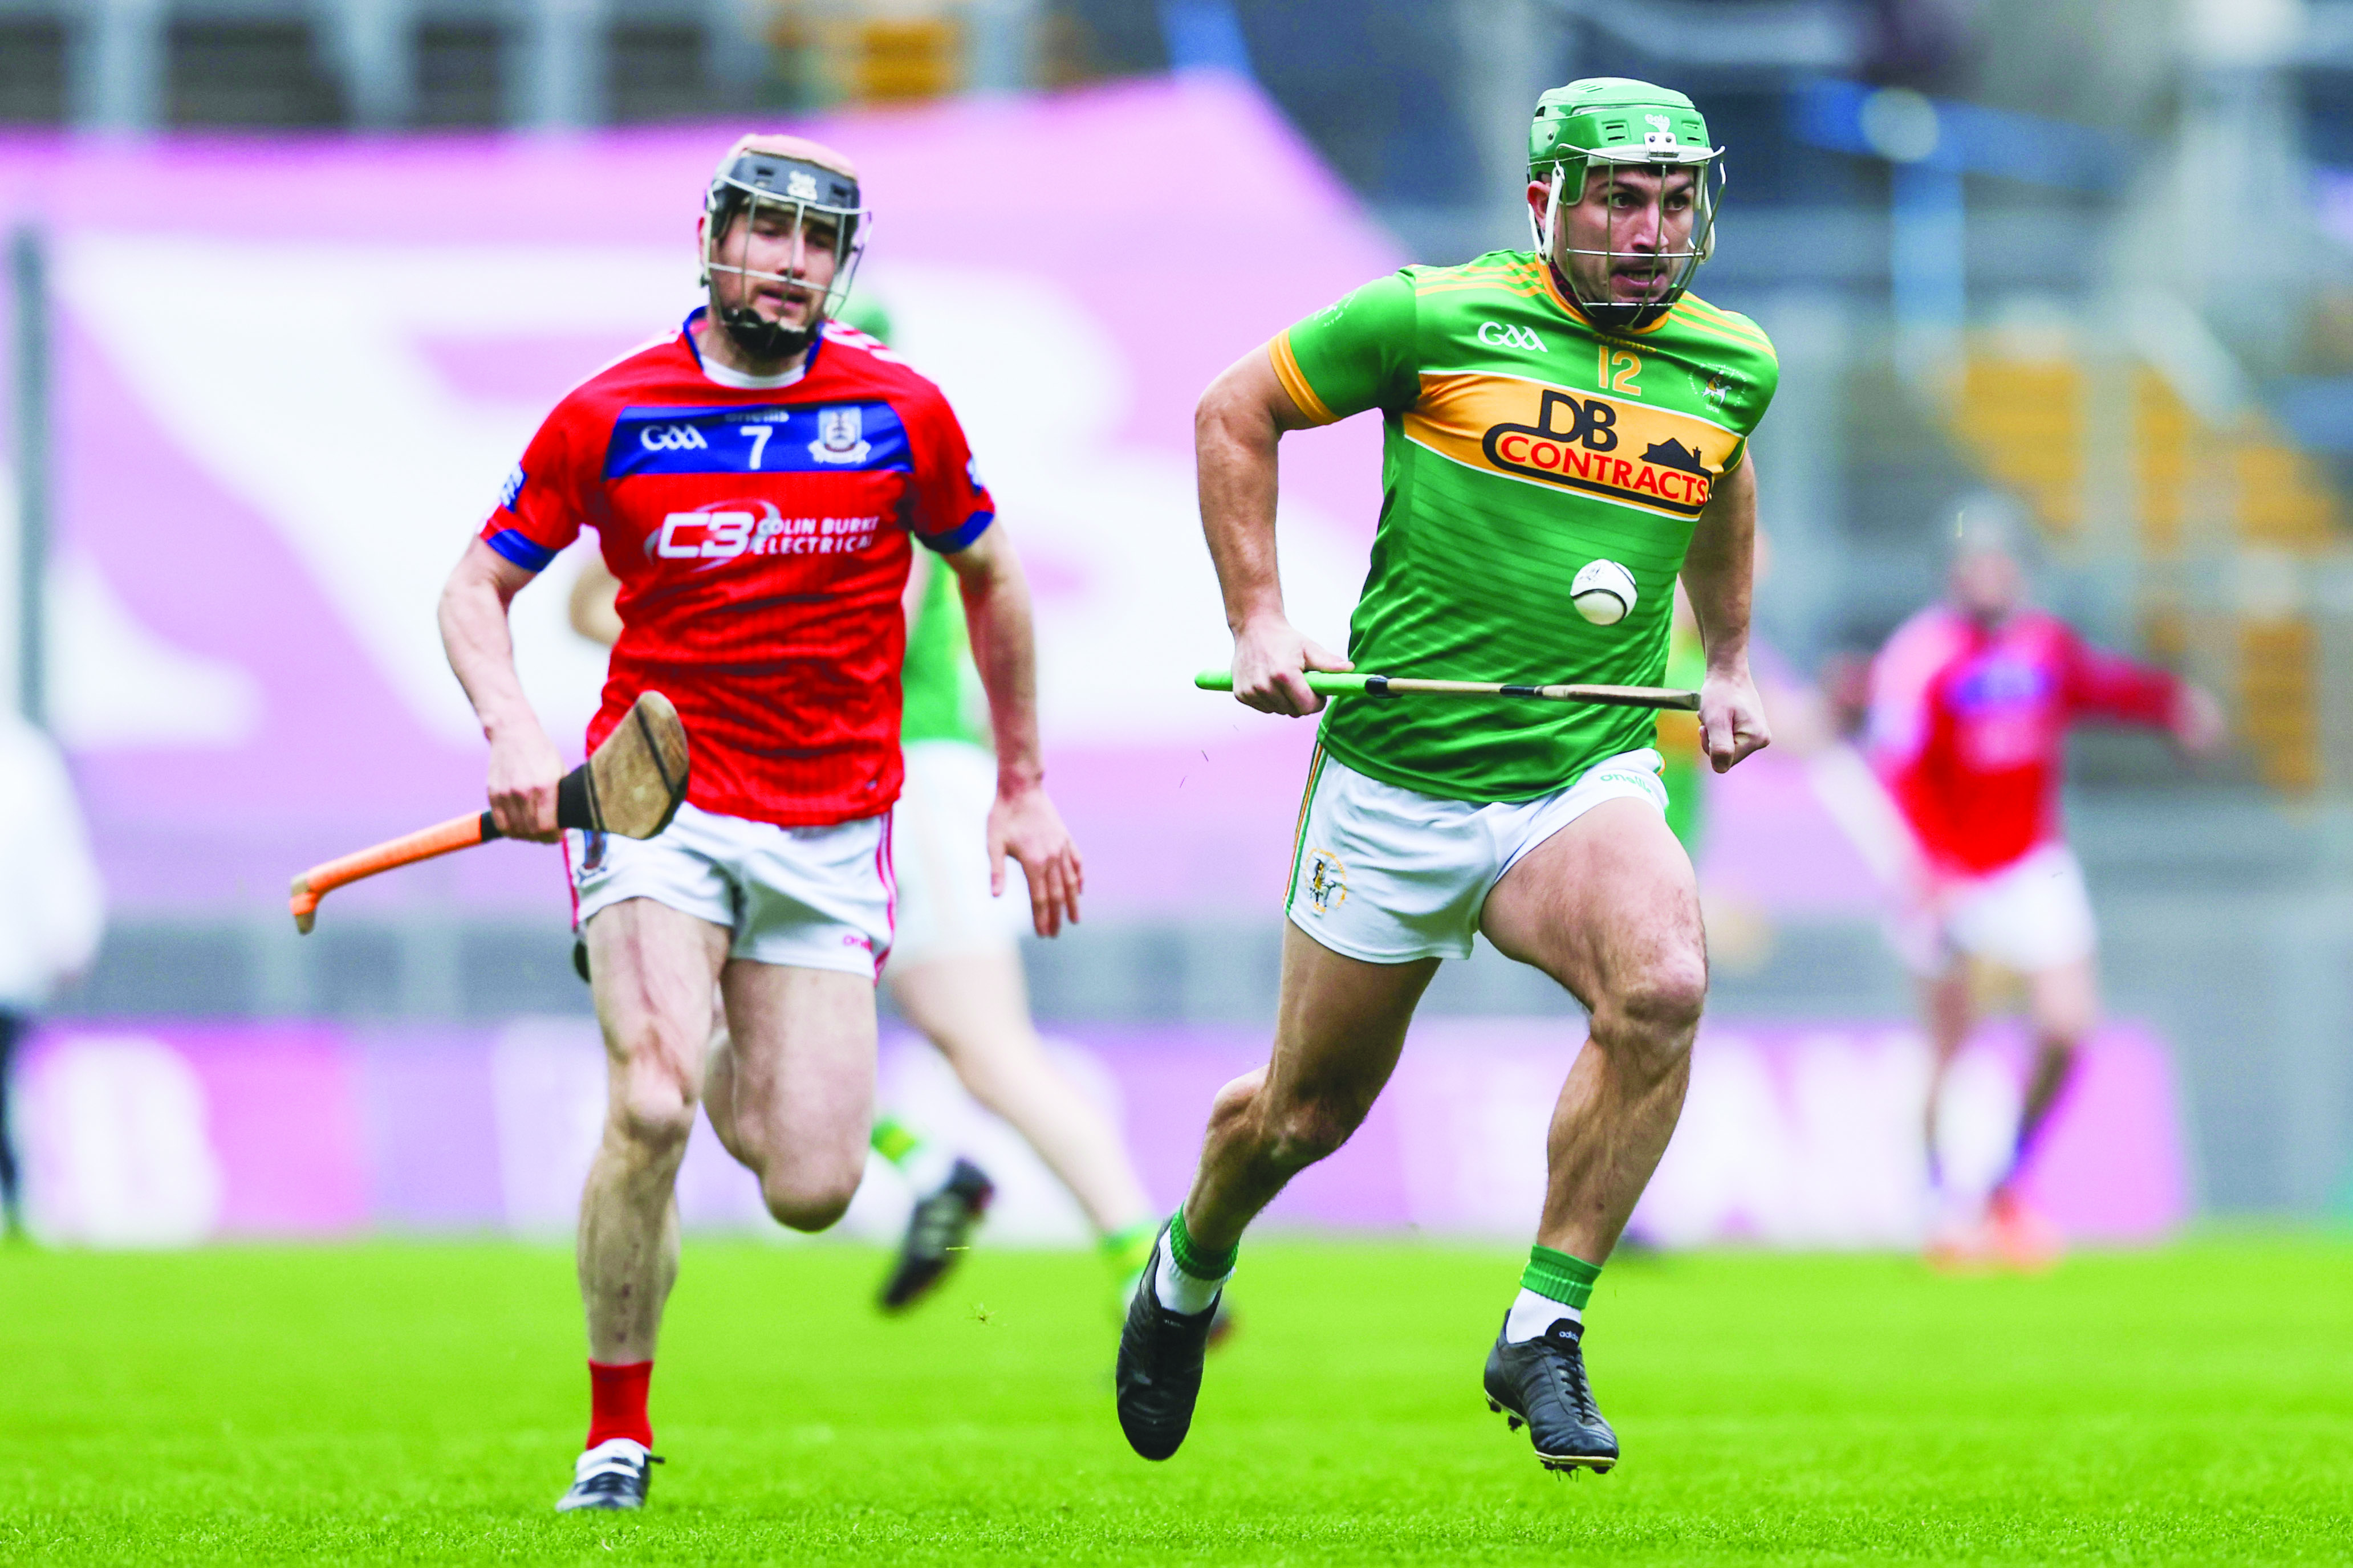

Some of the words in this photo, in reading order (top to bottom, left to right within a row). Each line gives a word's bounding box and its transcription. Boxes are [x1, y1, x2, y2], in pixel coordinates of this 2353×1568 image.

[1478, 321, 1549, 353] GAA
[1598, 345, 1642, 396] 12
[639, 423, 708, 451] GAA
[1539, 389, 1618, 452] DB
[740, 425, 773, 470] 7
[1500, 435, 1709, 506] CONTRACTS
[657, 512, 755, 559] C3
[756, 516, 817, 535] COLIN
